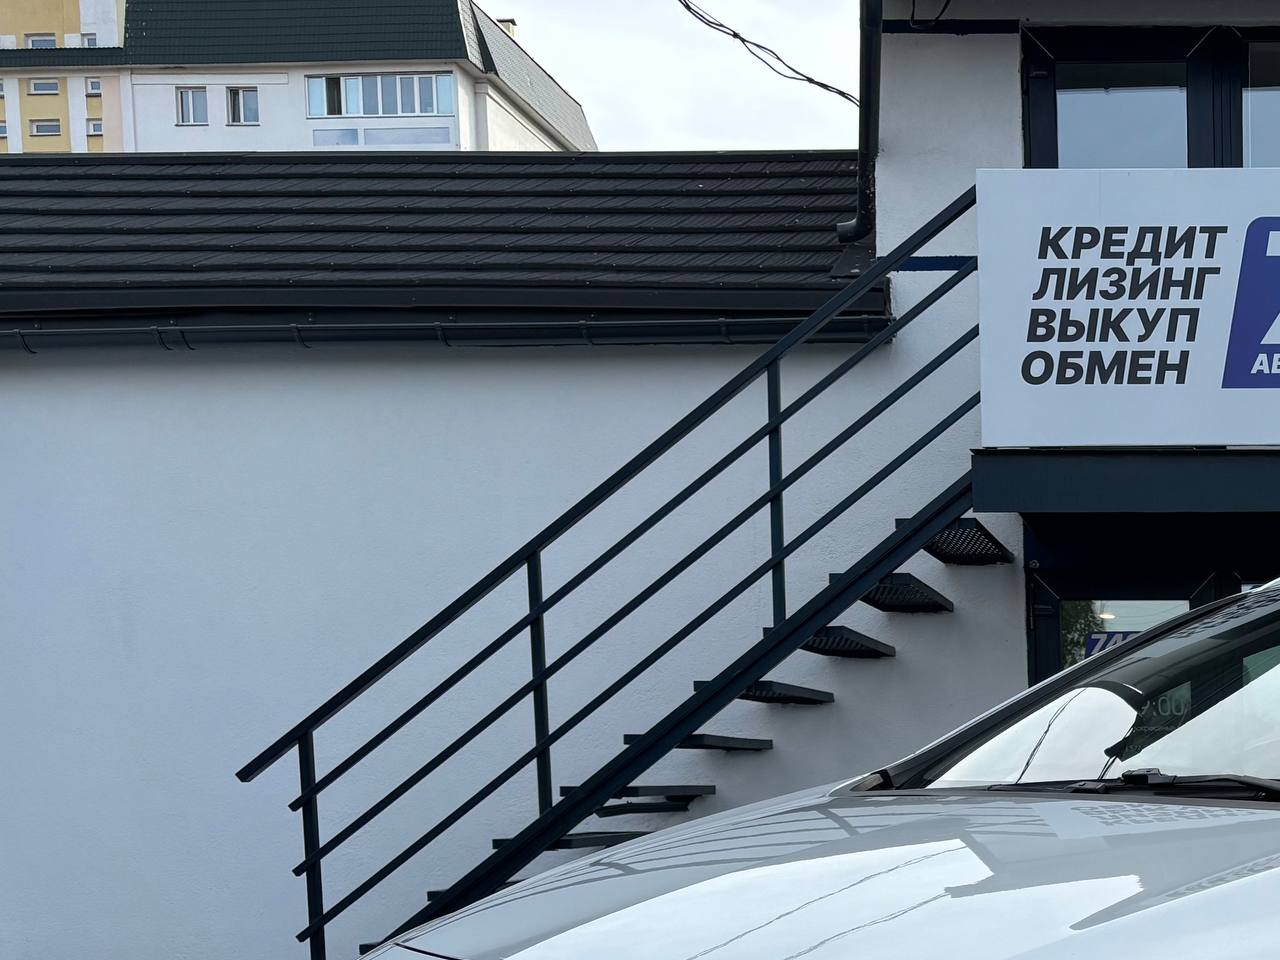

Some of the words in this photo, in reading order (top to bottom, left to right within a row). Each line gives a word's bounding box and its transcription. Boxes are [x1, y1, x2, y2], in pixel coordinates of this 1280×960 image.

[1037, 225, 1229, 267] КРЕДИТ
[1031, 266, 1221, 301] ЛИЗИНГ
[1026, 307, 1201, 343] ВЫКУП
[1021, 350, 1190, 386] ОБМЕН
[1091, 632, 1138, 655] 74
